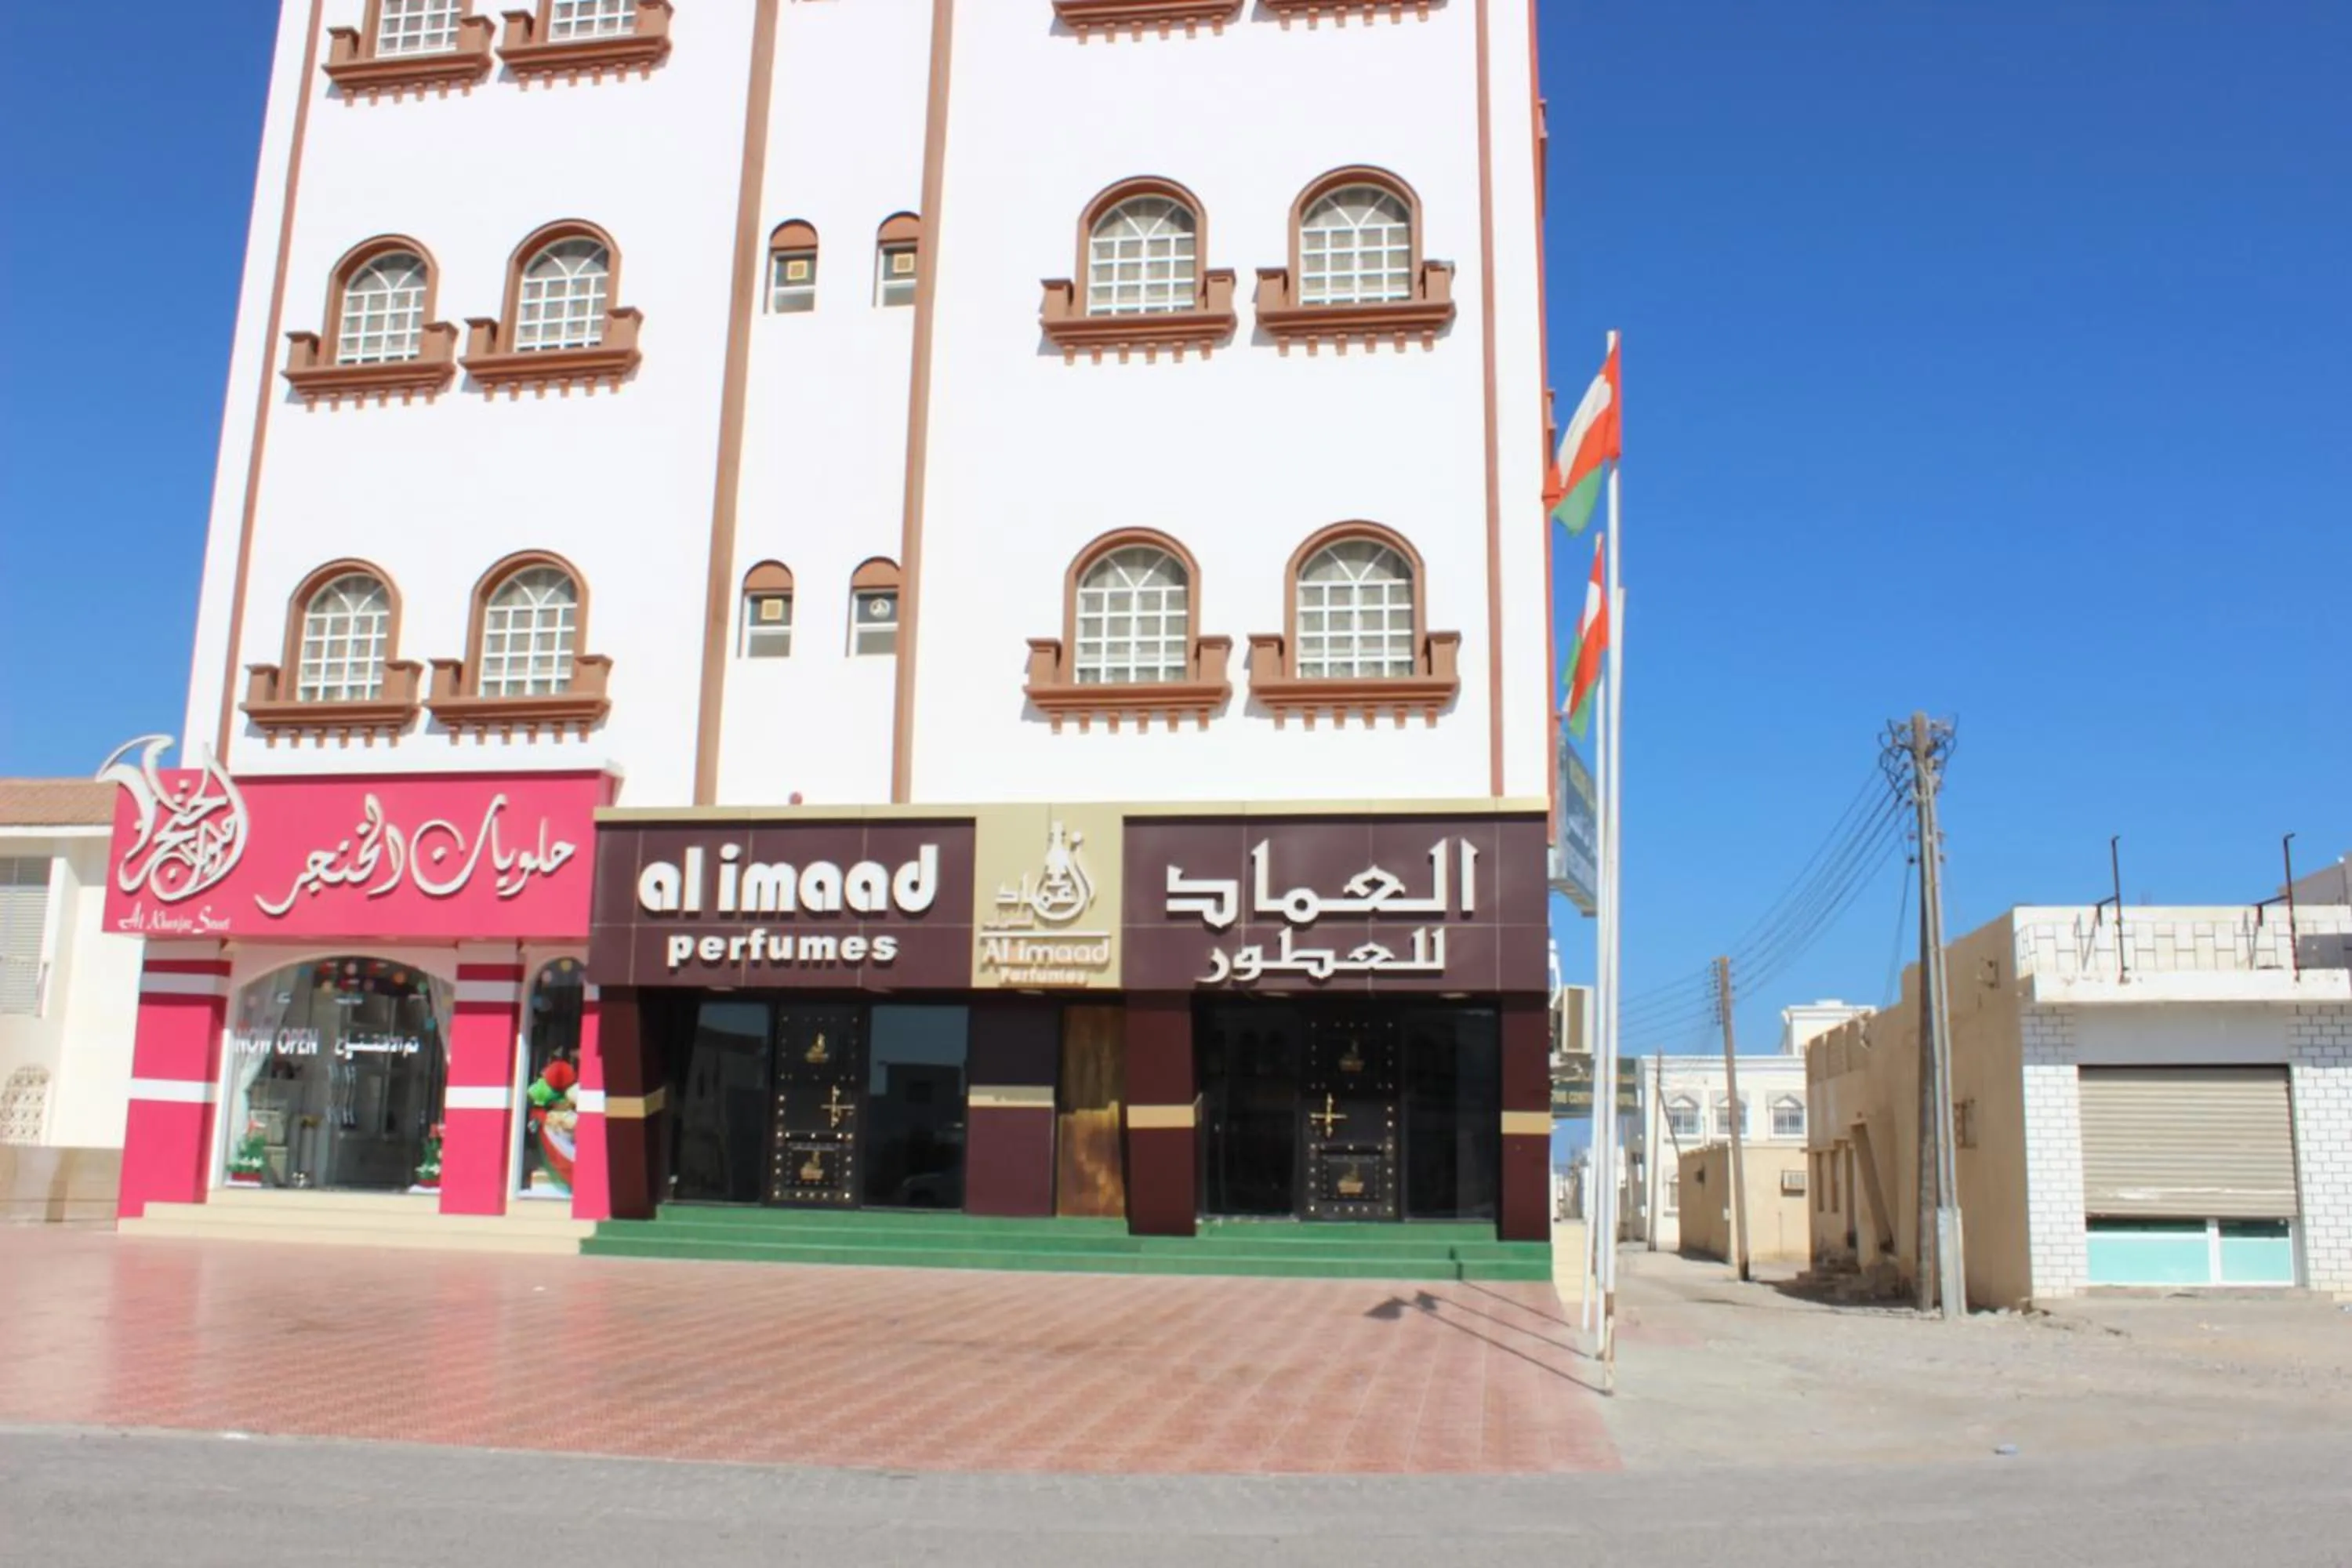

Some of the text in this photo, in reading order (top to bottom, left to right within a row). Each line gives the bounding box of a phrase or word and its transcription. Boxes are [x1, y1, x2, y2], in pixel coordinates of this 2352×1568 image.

[254, 793, 405, 915] الخنجر
[638, 843, 938, 913] al imaad
[1166, 838, 1479, 927] العماد
[667, 928, 898, 967] perfumes
[983, 938, 1008, 964] Al
[1196, 927, 1445, 982] للعطور
[235, 1028, 318, 1055] NOW OPEN
